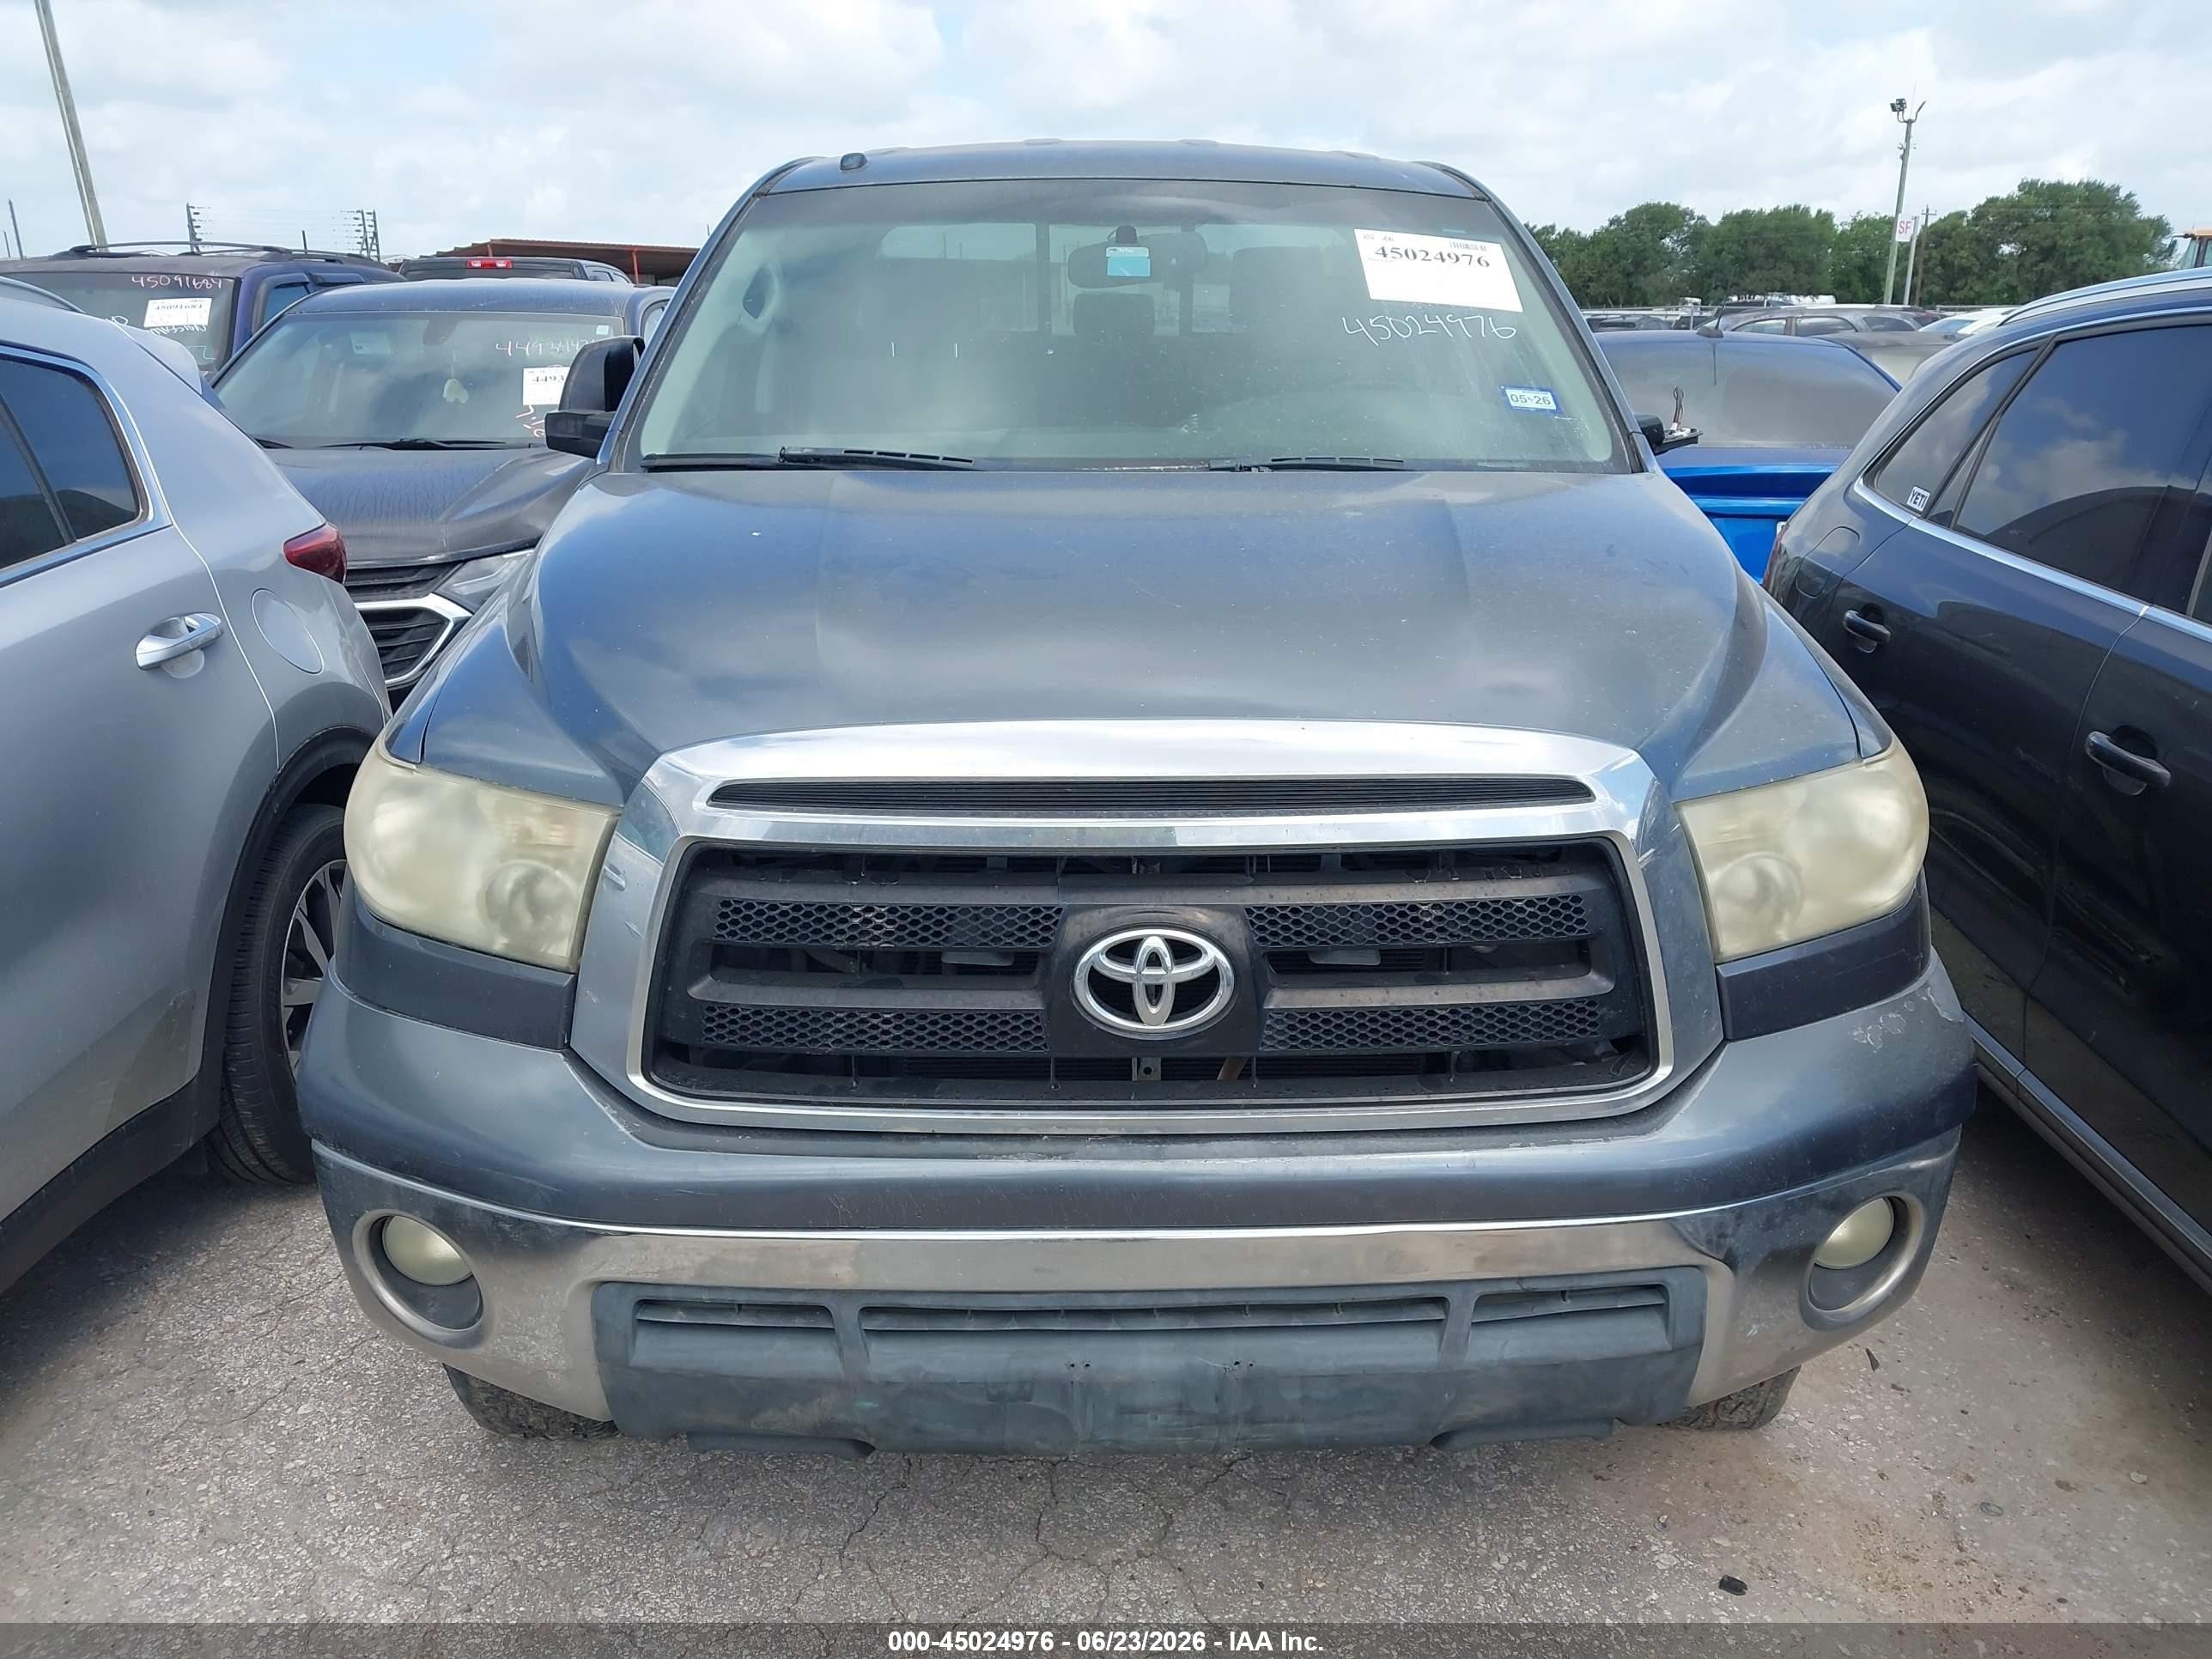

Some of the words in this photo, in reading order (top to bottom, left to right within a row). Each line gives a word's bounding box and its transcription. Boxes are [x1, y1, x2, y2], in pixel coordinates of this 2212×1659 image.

[1899, 221, 1911, 234] SF
[1375, 245, 1491, 268] 45024976
[131, 274, 222, 289] 45091684
[1341, 313, 1517, 347] 45024976
[1911, 489, 1927, 508] YETI
